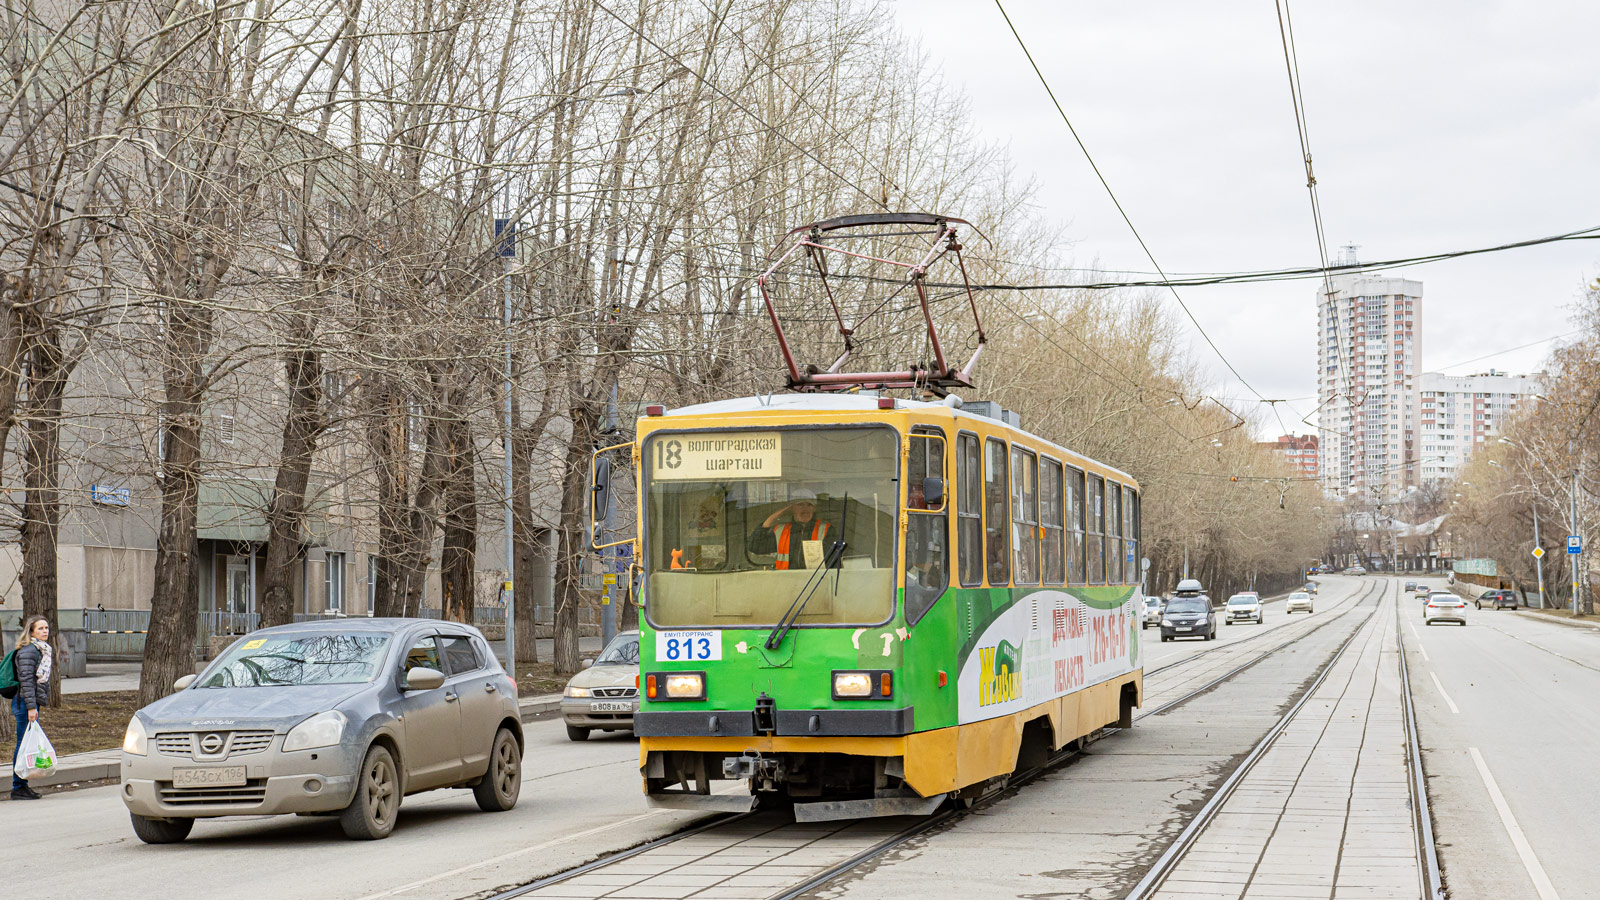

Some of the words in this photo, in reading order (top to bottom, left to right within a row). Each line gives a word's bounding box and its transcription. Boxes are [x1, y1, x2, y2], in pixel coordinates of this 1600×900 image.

[656, 439, 682, 470] 18
[666, 637, 711, 660] 813
[1093, 612, 1126, 664] 216-16-16
[1054, 655, 1084, 694] ЛЕКАРСТВ
